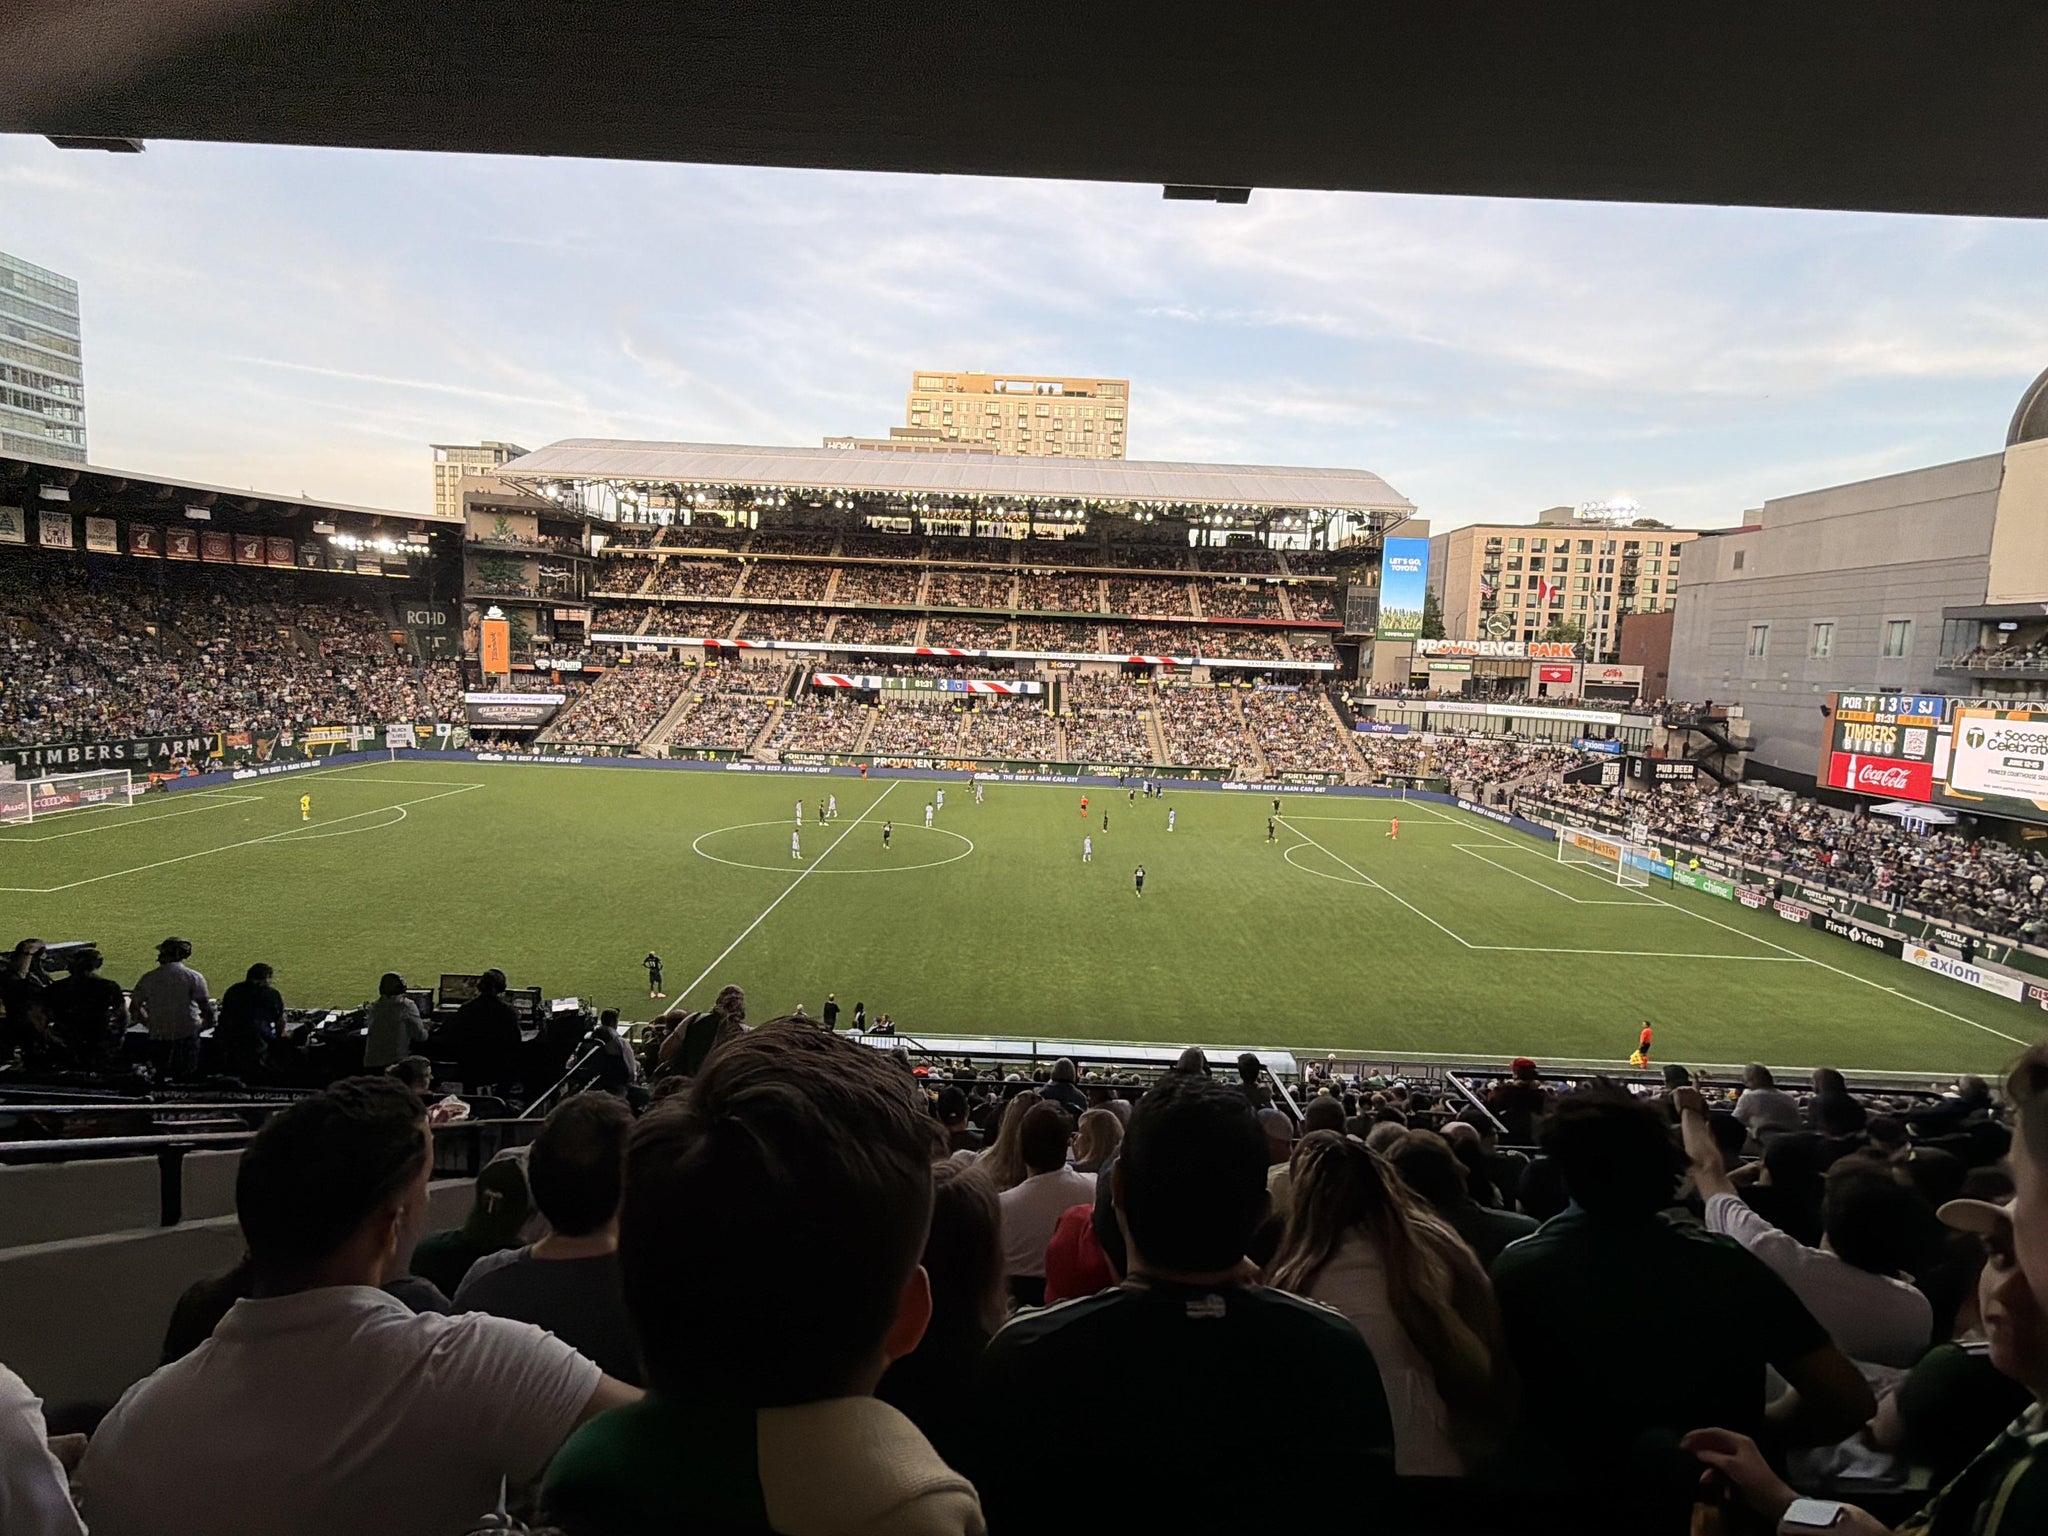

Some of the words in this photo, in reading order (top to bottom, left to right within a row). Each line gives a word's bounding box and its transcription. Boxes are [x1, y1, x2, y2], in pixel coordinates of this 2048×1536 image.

[44, 535, 68, 546] WINE
[1416, 639, 1525, 658] PROVIDENCE
[1528, 642, 1577, 658] PARK
[901, 678, 907, 689] 1
[940, 679, 948, 690] 3
[1842, 696, 1863, 709] POR
[1879, 697, 1886, 711] 1
[1888, 698, 1898, 712] 3
[1918, 701, 1934, 714] SJ
[1371, 723, 1394, 733] xfinity
[1844, 723, 1898, 743] TIMBERS
[18, 745, 125, 766] TIMBERS
[159, 737, 213, 756] ARMY
[1843, 738, 1893, 754] BINGO
[477, 753, 504, 761] Gillette
[2007, 759, 2023, 767] JUNE
[233, 768, 257, 780] Gillette
[300, 761, 312, 769] CAN
[726, 763, 752, 771] Gillette
[873, 757, 947, 771] PROVIDENE
[947, 760, 978, 772] PARK
[1602, 765, 1620, 775] PUB
[1656, 764, 1673, 774] PUB
[1673, 764, 1694, 774] BEER
[974, 772, 1000, 780] Gillette
[1601, 774, 1619, 783] BEER
[1987, 768, 2007, 777] PIONEER
[2007, 770, 2038, 781] COURTHOUSE
[1222, 782, 1248, 790] Gillette
[2, 802, 27, 813] Audi
[1701, 857, 1726, 870] PORTLAND
[1673, 870, 1697, 887] chime
[1703, 878, 1729, 897] chime
[1735, 889, 1767, 905] DISCOUNT
[1742, 897, 1757, 907] TIRE
[1802, 888, 1836, 904] PORTLAND
[1774, 902, 1809, 918] DISCOUNT
[1782, 911, 1798, 920] TIRE
[1825, 919, 1848, 936] First
[1860, 931, 1884, 948] Tech
[1930, 956, 1981, 984] axiom
